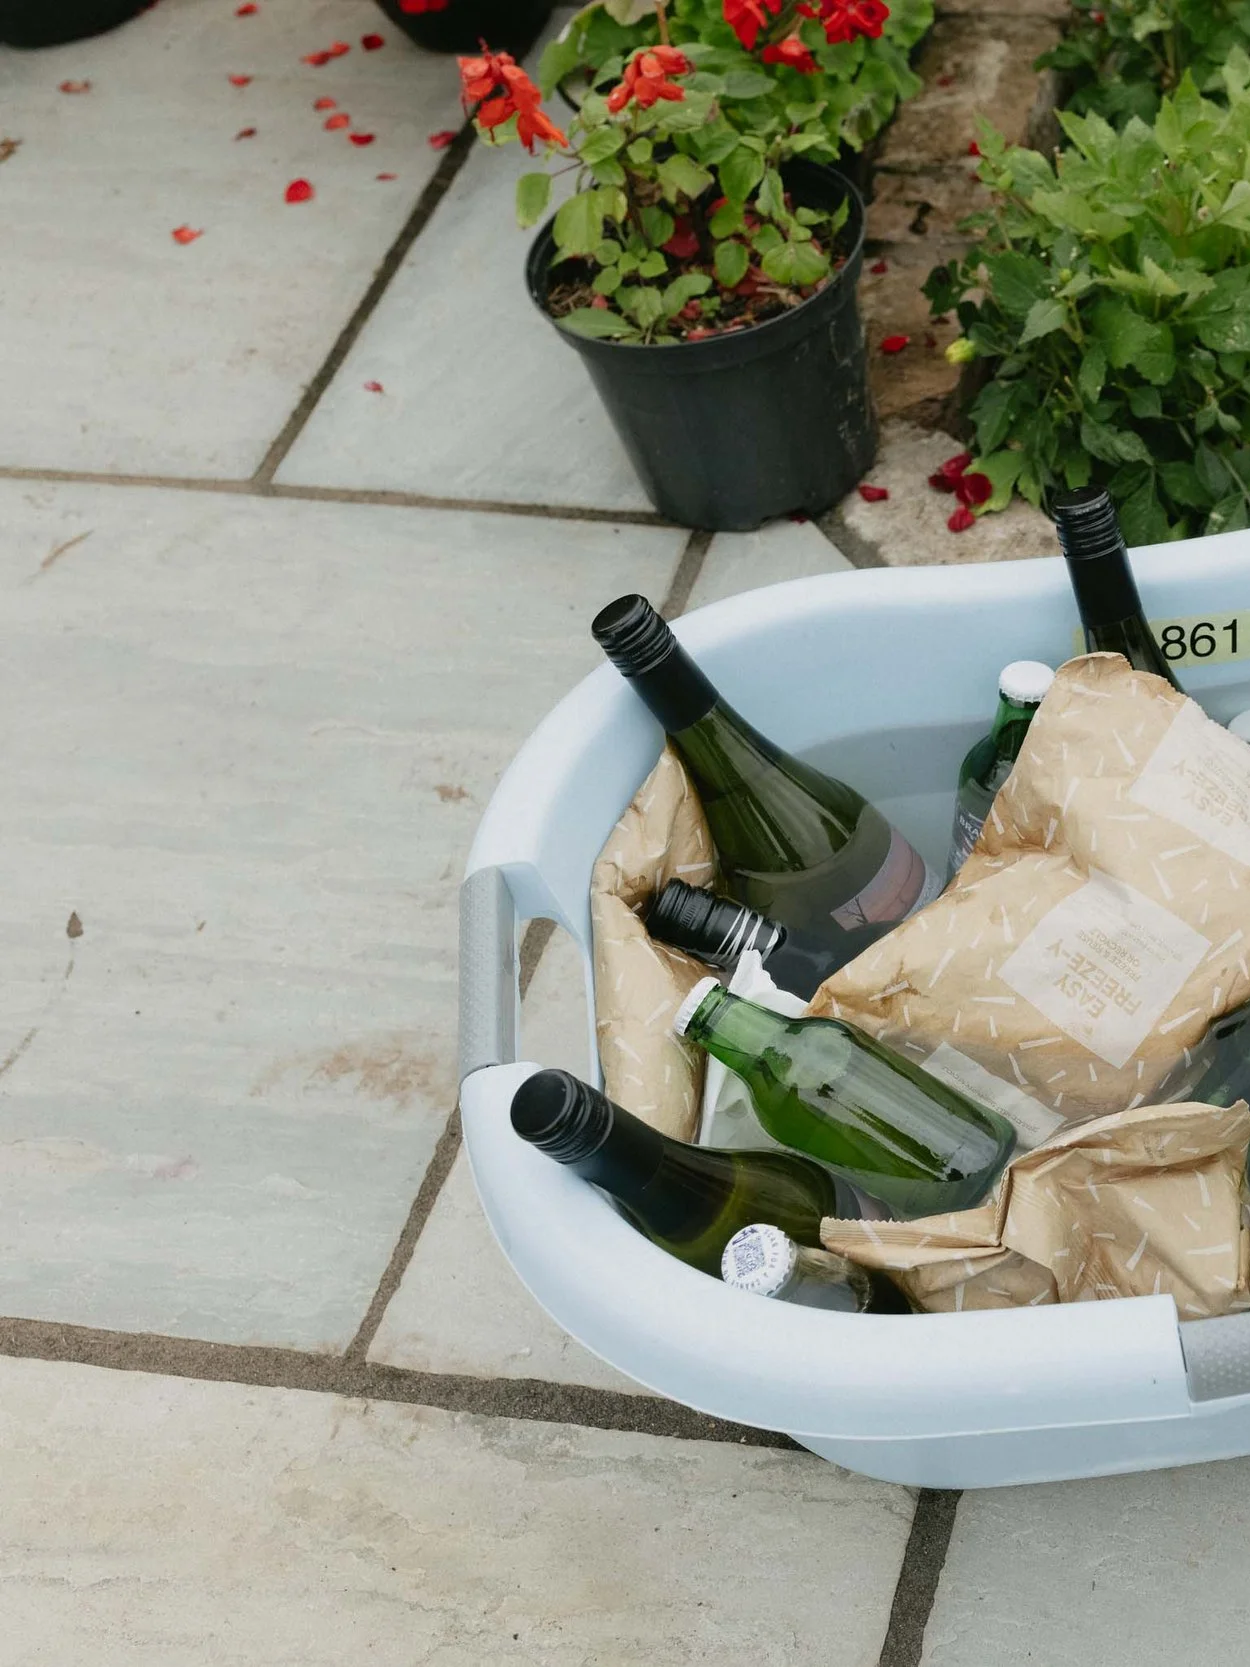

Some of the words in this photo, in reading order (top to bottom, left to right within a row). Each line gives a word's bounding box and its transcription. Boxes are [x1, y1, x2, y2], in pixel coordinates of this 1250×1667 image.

[1161, 619, 1238, 660] 861
[1046, 938, 1143, 1016] FREEZE-Y
[1052, 973, 1107, 1019] EASY
